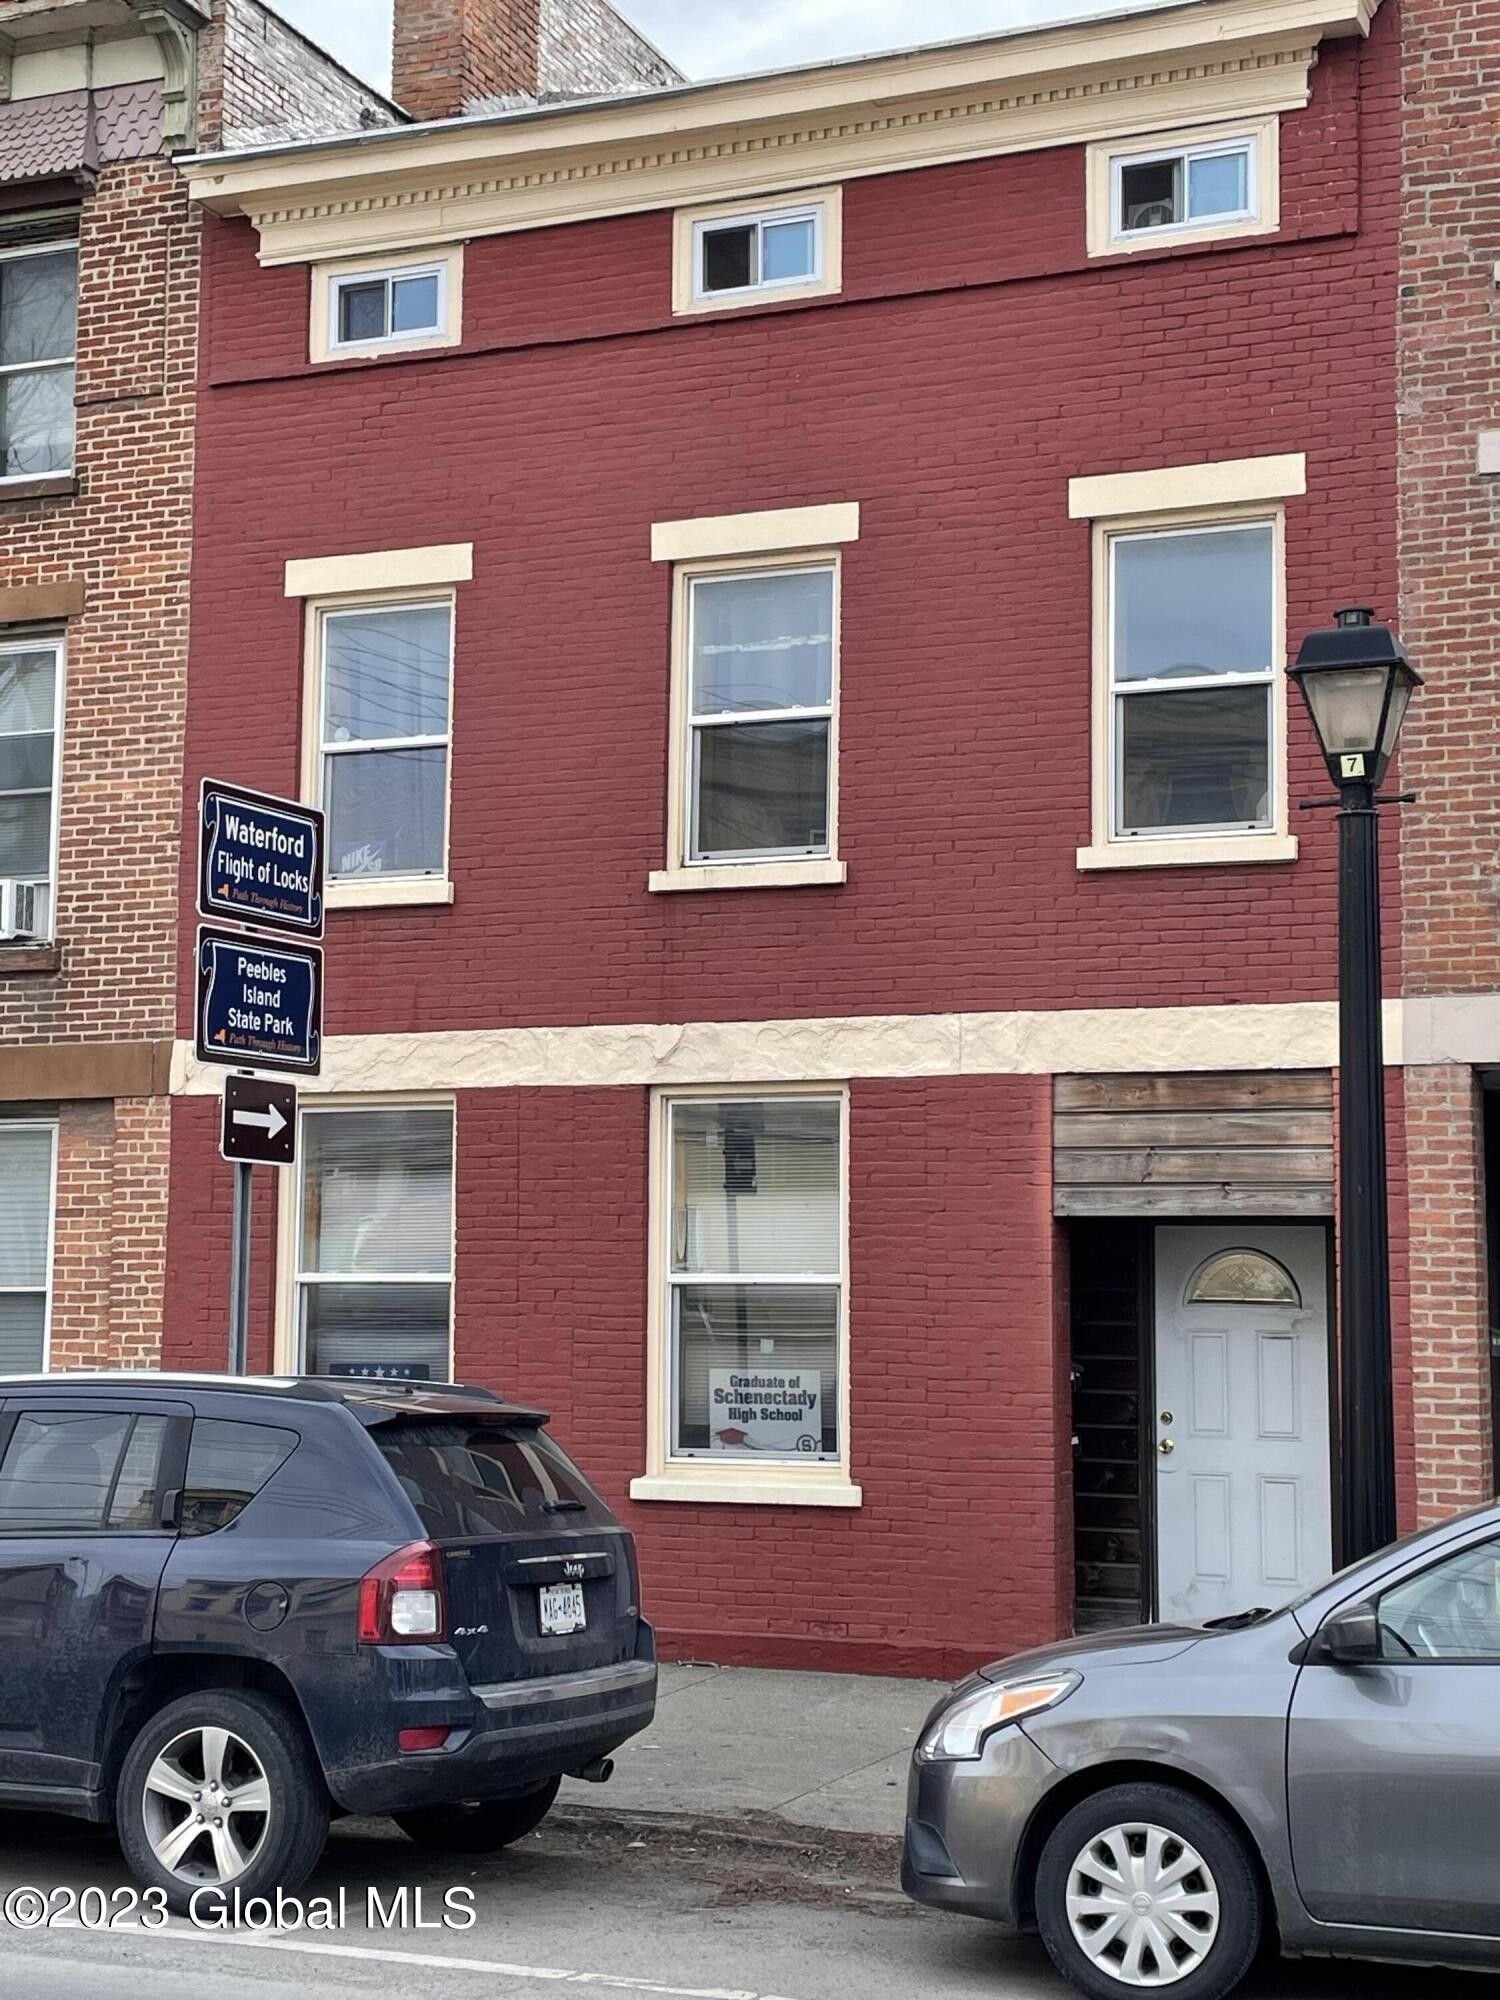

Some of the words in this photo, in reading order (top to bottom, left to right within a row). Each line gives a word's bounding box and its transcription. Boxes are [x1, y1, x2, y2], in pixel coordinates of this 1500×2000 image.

[1346, 757, 1358, 772] 7
[225, 813, 305, 859] Waterford
[341, 844, 371, 872] NIKE
[218, 850, 255, 884] Flight
[258, 861, 271, 884] of
[274, 863, 309, 893] Locks
[237, 956, 287, 984] Peebles
[243, 983, 281, 1009] Island
[227, 1007, 261, 1031] State
[264, 1012, 295, 1037] Park
[729, 1374, 785, 1389] Graduate
[788, 1375, 801, 1389] of
[713, 1387, 817, 1410] Schenectady
[728, 1407, 758, 1424] High
[760, 1408, 803, 1422] School
[563, 1561, 585, 1578] Jeep
